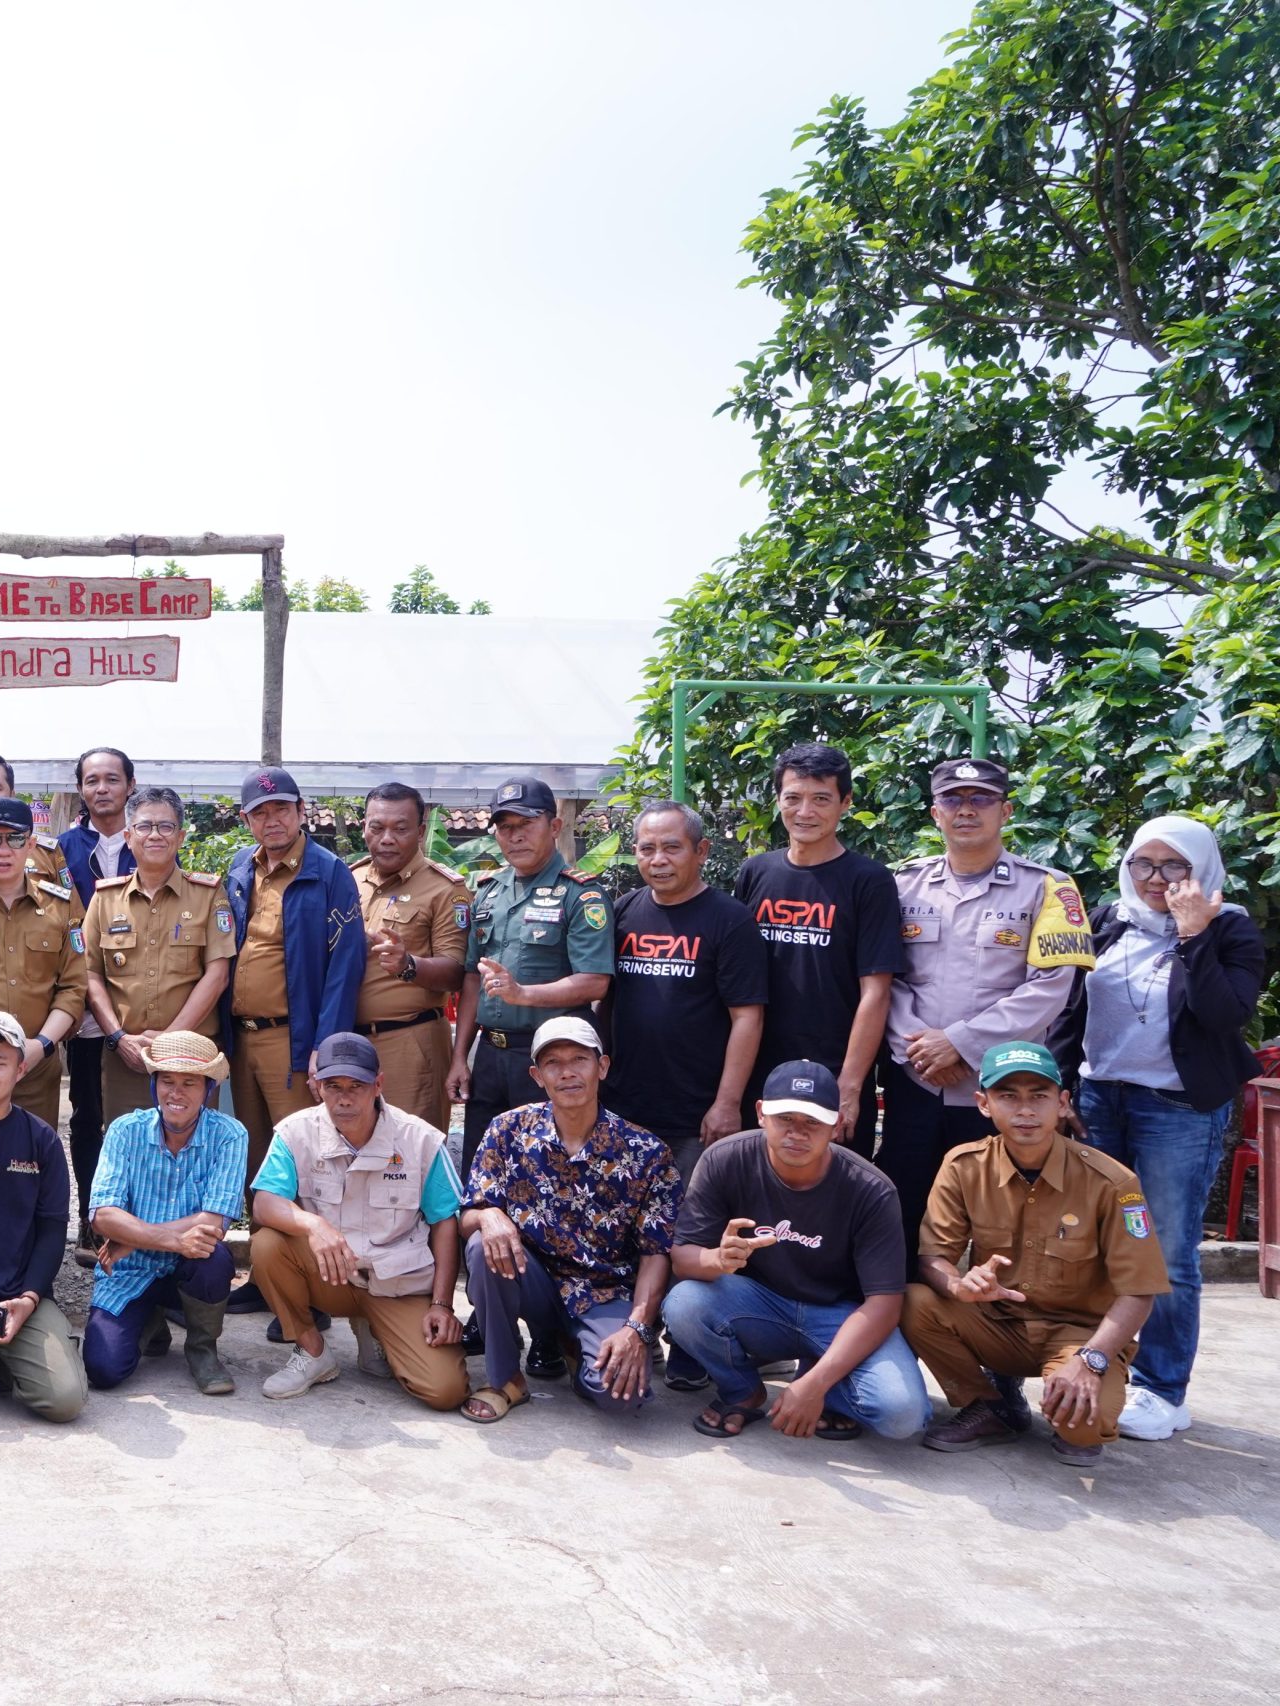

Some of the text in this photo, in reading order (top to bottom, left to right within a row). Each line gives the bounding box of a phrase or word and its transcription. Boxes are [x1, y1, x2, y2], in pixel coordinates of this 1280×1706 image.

[756, 899, 836, 929] ASPAI
[620, 932, 701, 960] ASPAI
[760, 929, 831, 946] RINGSEWU
[383, 1173, 407, 1181] PKSM
